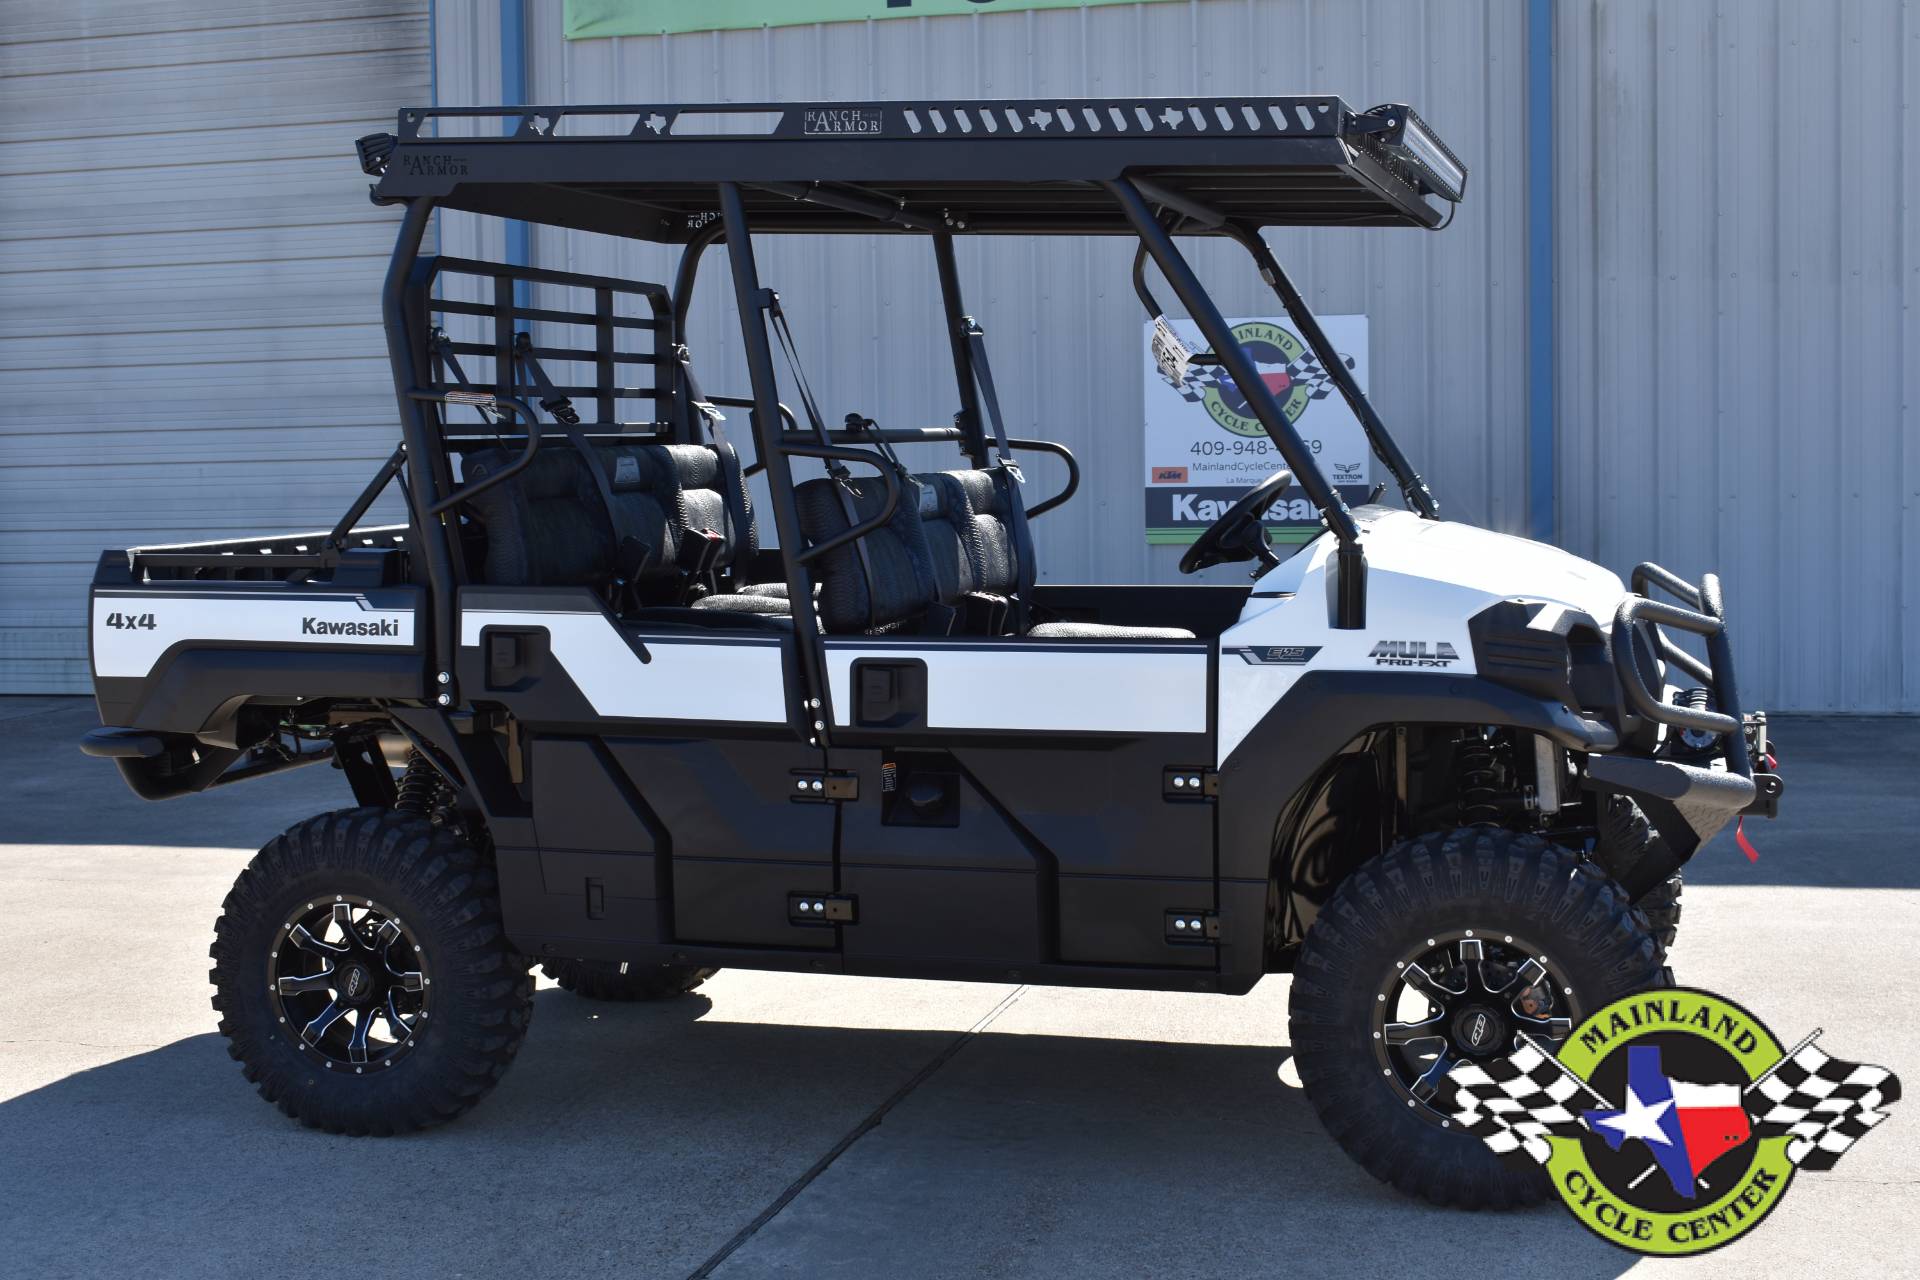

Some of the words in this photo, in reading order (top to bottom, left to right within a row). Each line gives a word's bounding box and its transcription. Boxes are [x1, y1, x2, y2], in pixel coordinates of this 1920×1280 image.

[807, 110, 861, 122] RANCH
[813, 111, 879, 131] ARMOR
[409, 155, 468, 175] ARMOR
[1238, 327, 1293, 350] INLAND
[1211, 401, 1248, 431] CYCLE
[1190, 440, 1322, 456] 409-948-9
[106, 612, 157, 630] 4x4
[302, 617, 399, 637] Kawasaki
[1368, 640, 1460, 660] MULE
[1376, 658, 1452, 668] PRO-FXT
